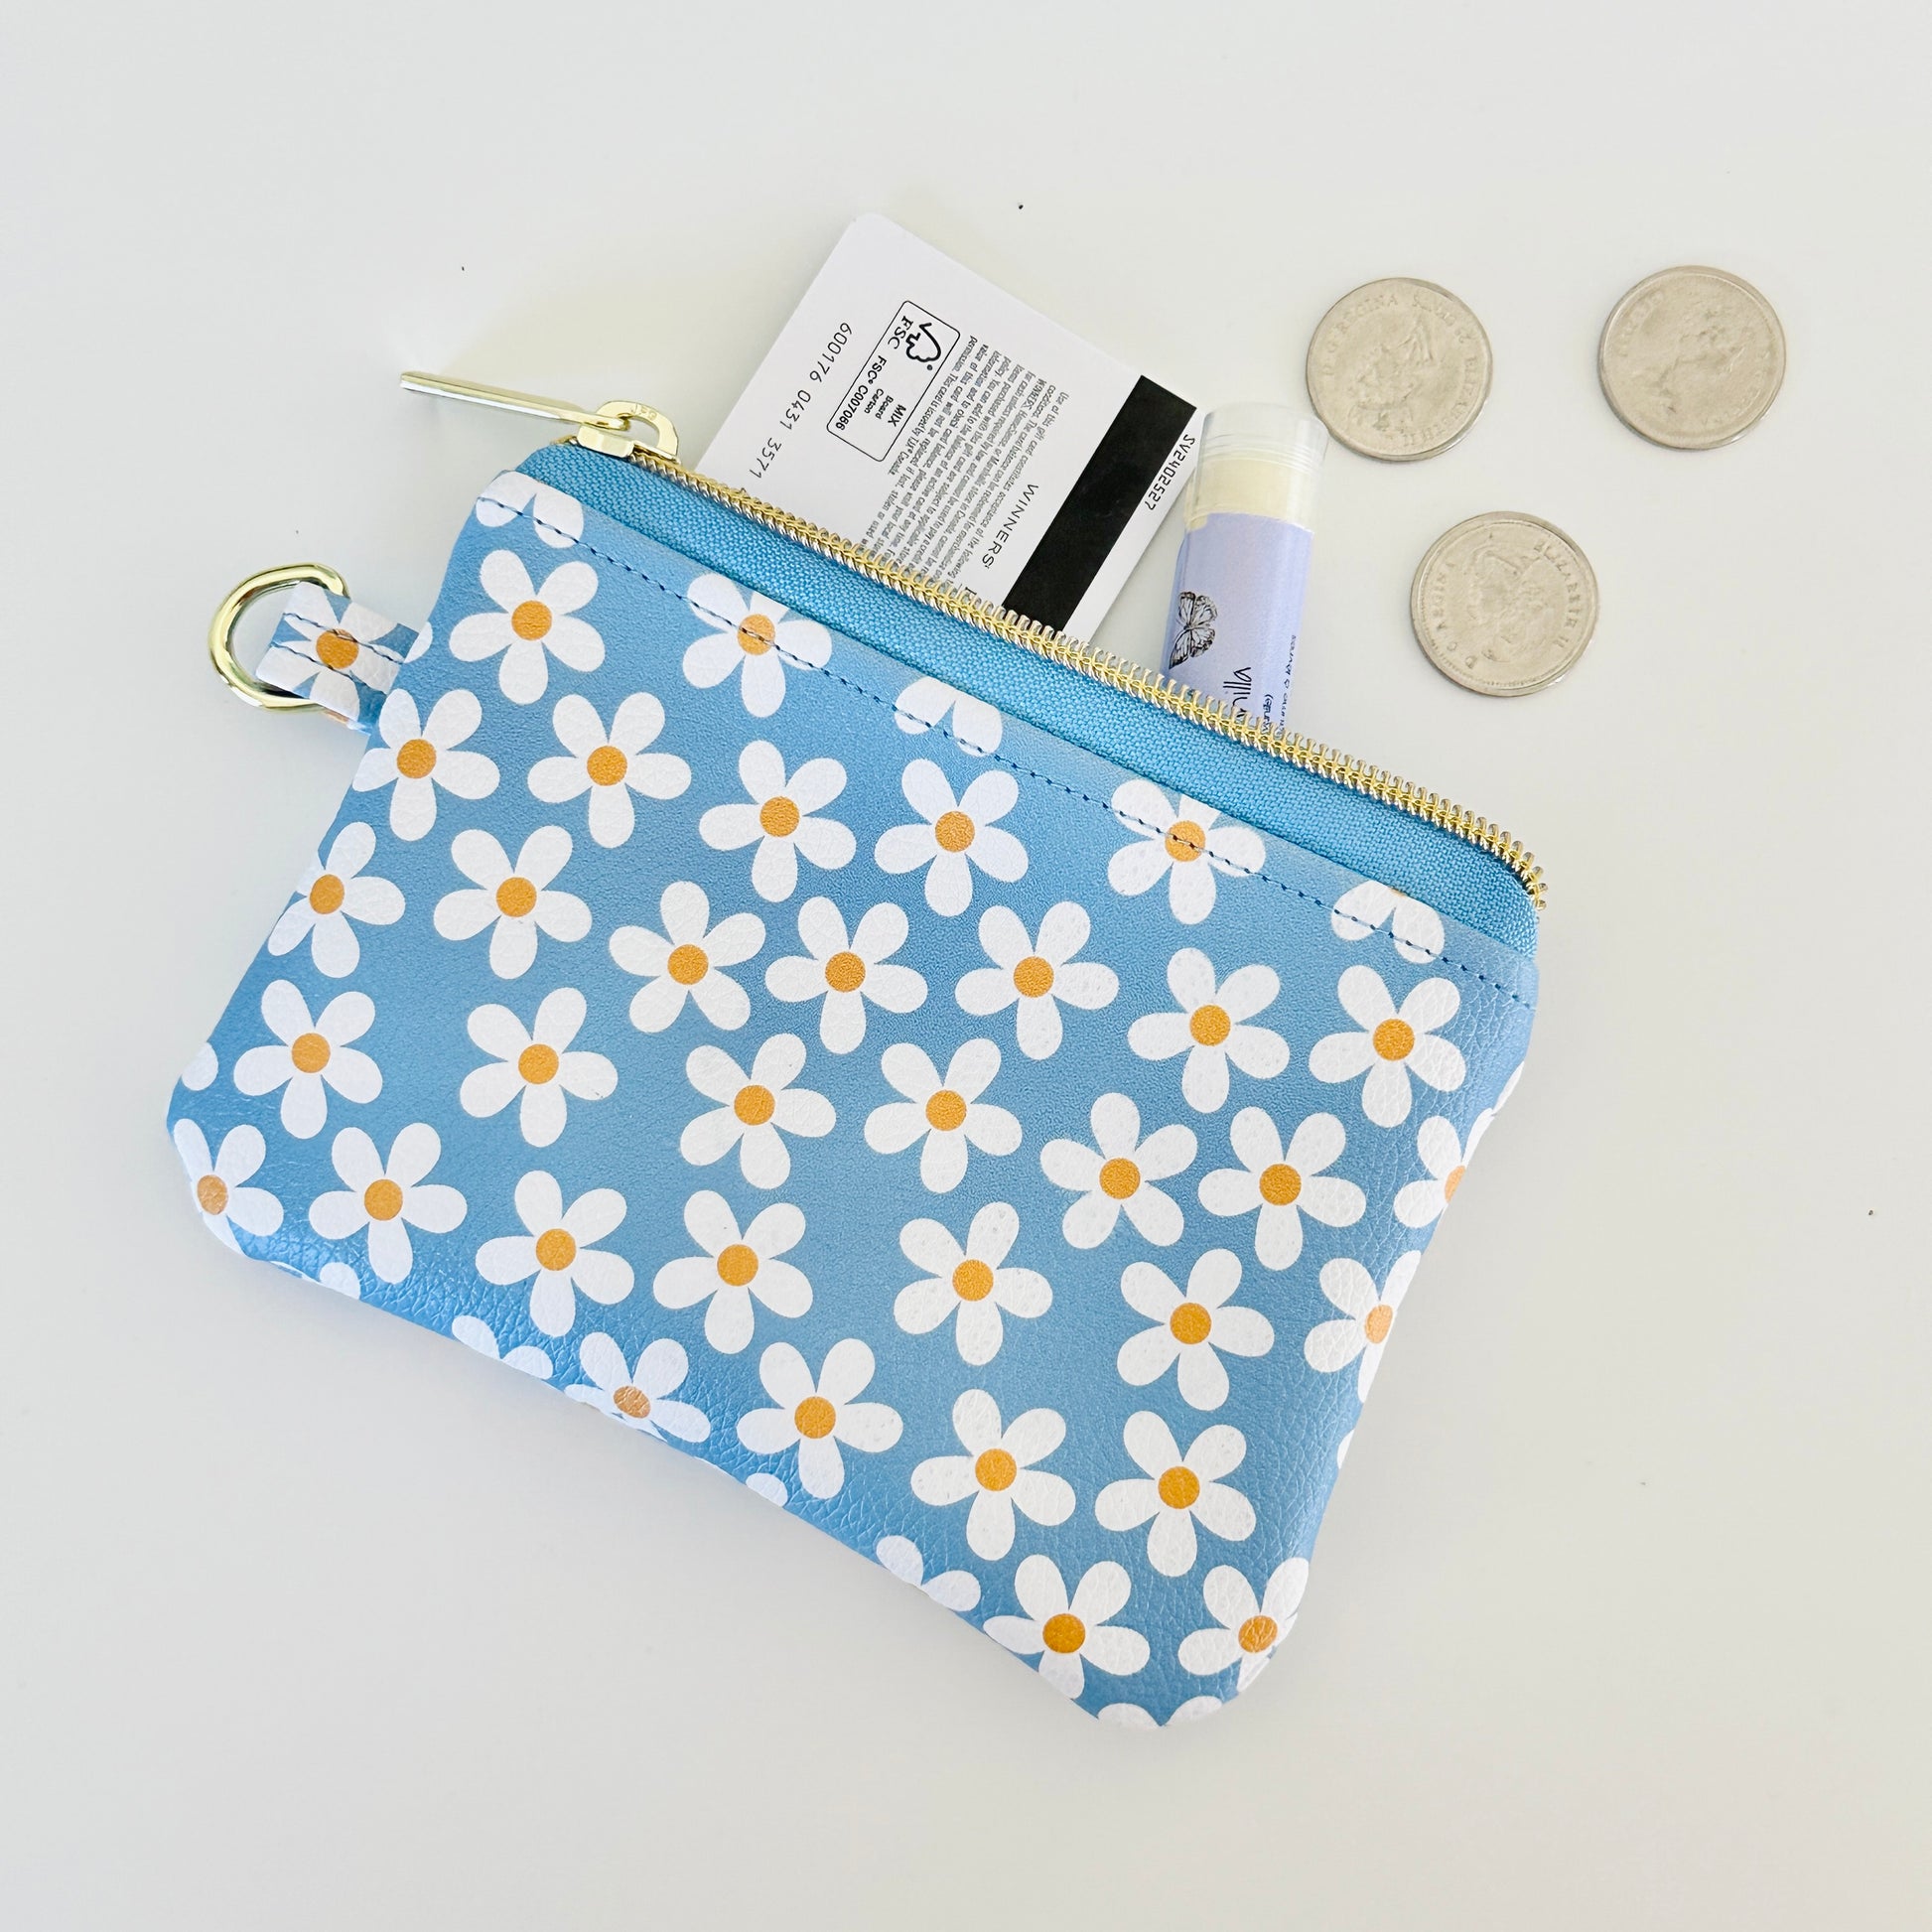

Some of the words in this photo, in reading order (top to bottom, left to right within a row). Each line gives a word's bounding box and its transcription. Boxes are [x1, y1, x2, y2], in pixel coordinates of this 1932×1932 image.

[808, 322, 853, 383] 600176
[887, 315, 914, 350] FSC
[778, 389, 812, 431] 0431
[834, 384, 869, 431] C007066
[863, 387, 885, 415] Carton
[874, 394, 895, 420] Board
[887, 403, 907, 428] MIX
[749, 437, 782, 479] 3571
[1144, 434, 1195, 511] SV2402527
